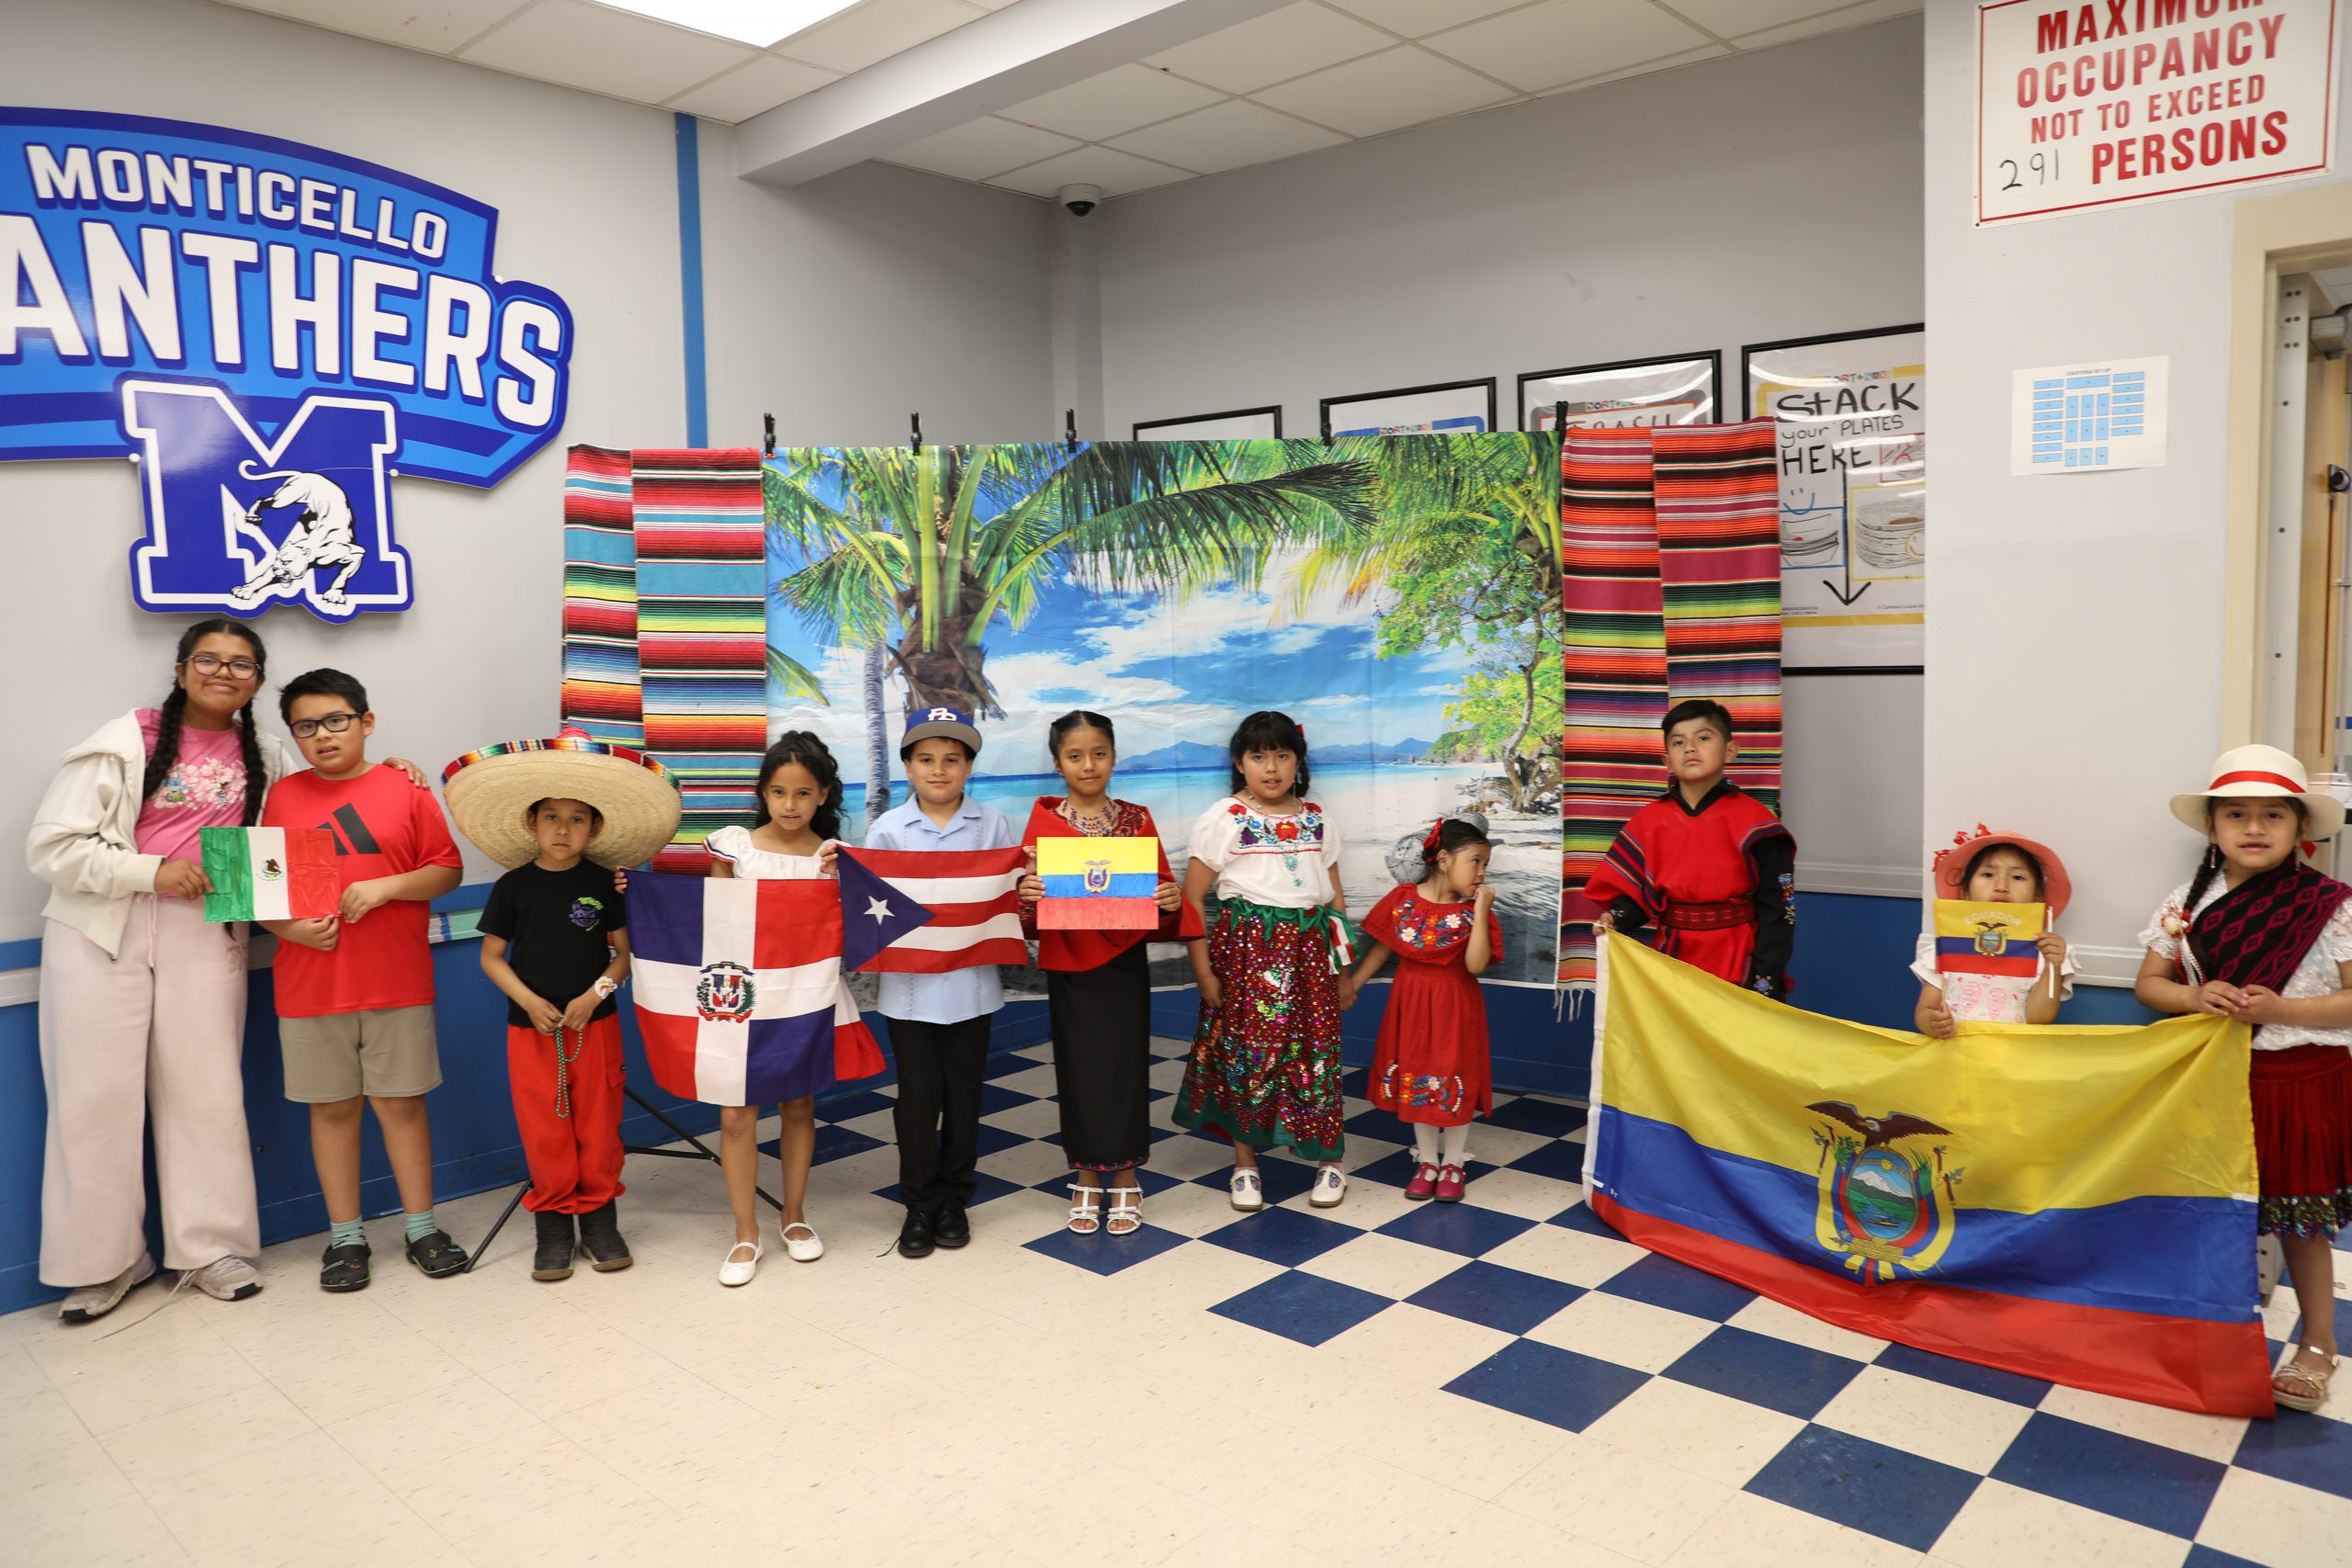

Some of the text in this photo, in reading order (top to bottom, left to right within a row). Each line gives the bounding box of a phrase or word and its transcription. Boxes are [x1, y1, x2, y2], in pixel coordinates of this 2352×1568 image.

[2017, 14, 2286, 108] OCCUPANCY
[2031, 73, 2265, 144] NOT TO EXCEED
[1999, 110, 2289, 191] 291 PERSONS
[24, 142, 447, 260] MONTICELLO
[1781, 414, 1905, 449] your PLATES
